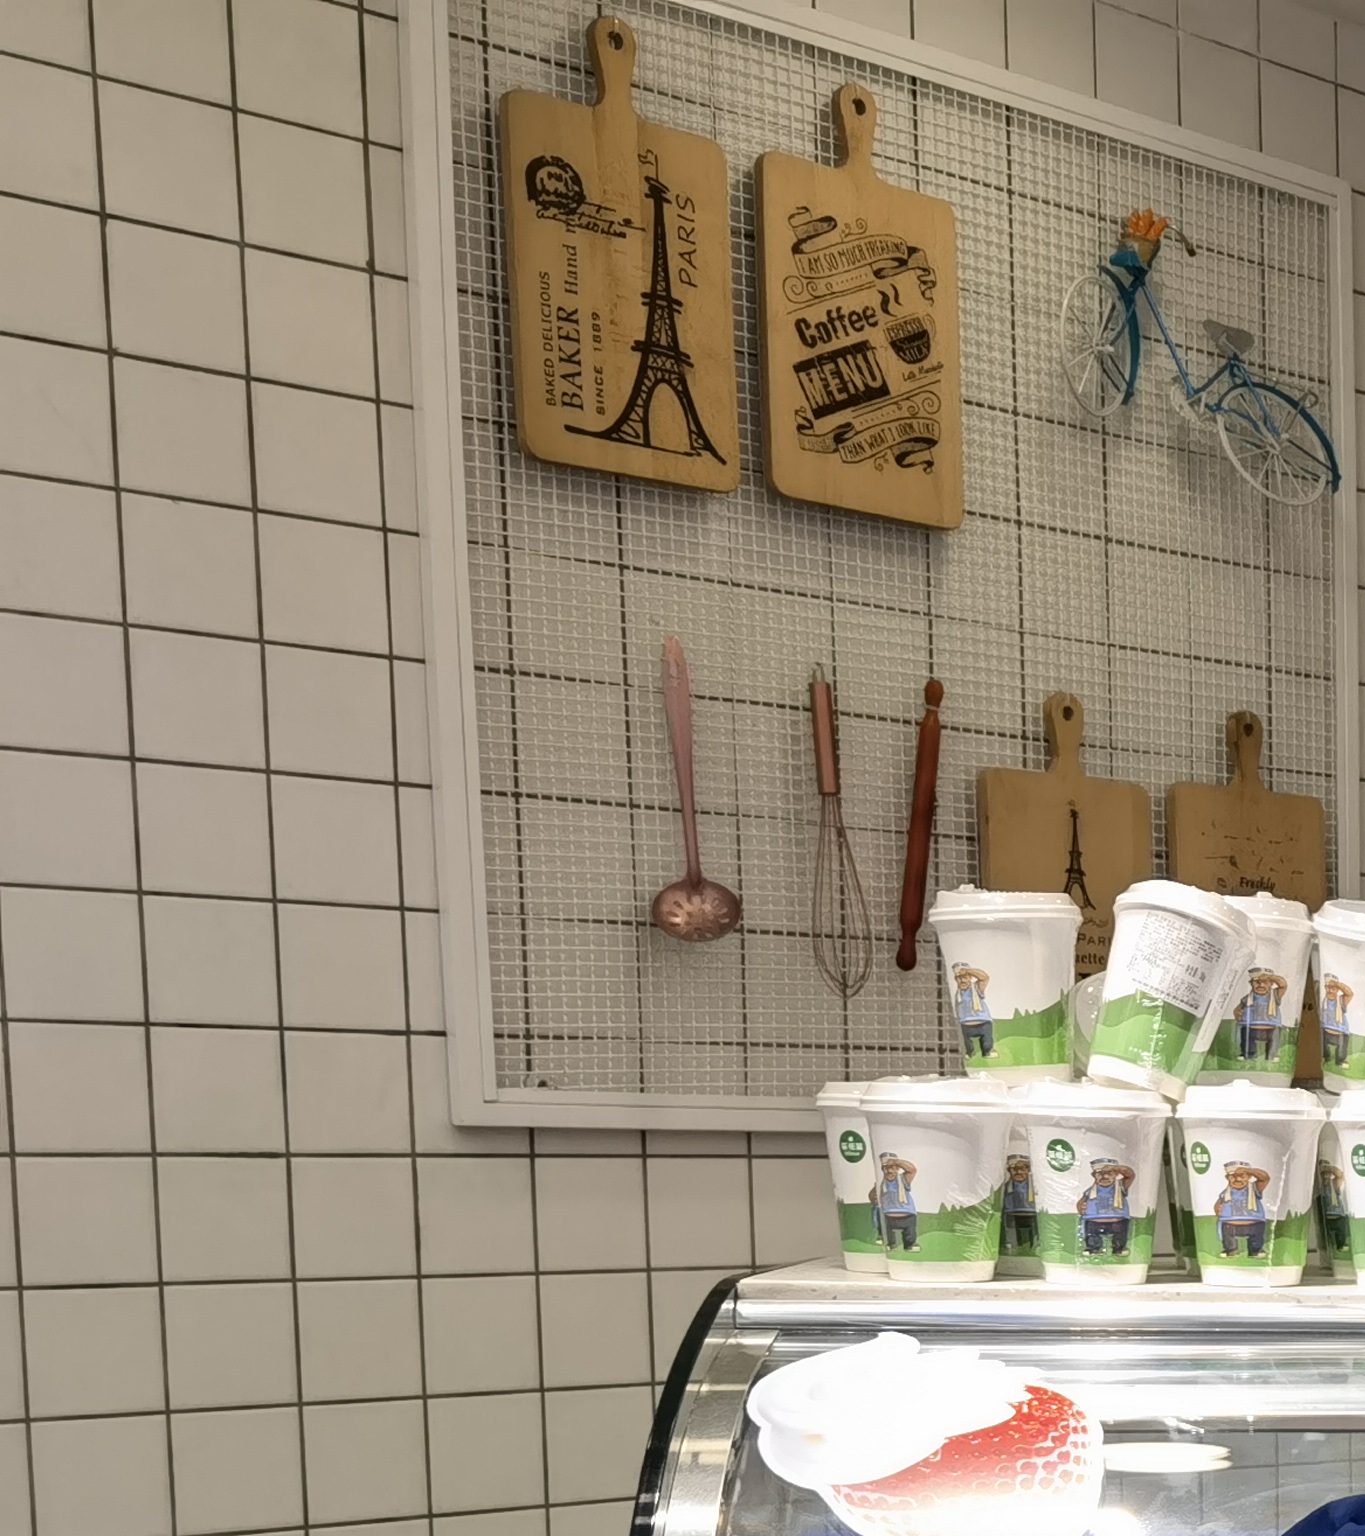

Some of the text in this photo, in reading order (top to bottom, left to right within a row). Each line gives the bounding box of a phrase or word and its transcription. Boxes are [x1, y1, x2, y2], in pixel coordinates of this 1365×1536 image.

[676, 193, 699, 288] PARIS
[807, 253, 824, 275] AM
[824, 251, 839, 271] SO
[839, 245, 866, 269] MUCH
[865, 238, 907, 263] FREAKING
[562, 244, 579, 296] Hand
[539, 270, 557, 406] BAKED DELICIOUS
[794, 305, 879, 349] Coffee
[557, 306, 584, 411] BAKER
[591, 311, 606, 416] SINCE 1889
[800, 349, 884, 411] MENU
[841, 440, 866, 460] THAN
[867, 431, 887, 450] WHAT
[896, 424, 917, 441] LOOK
[917, 420, 936, 437] LIKE
[1077, 933, 1111, 946] PARI
